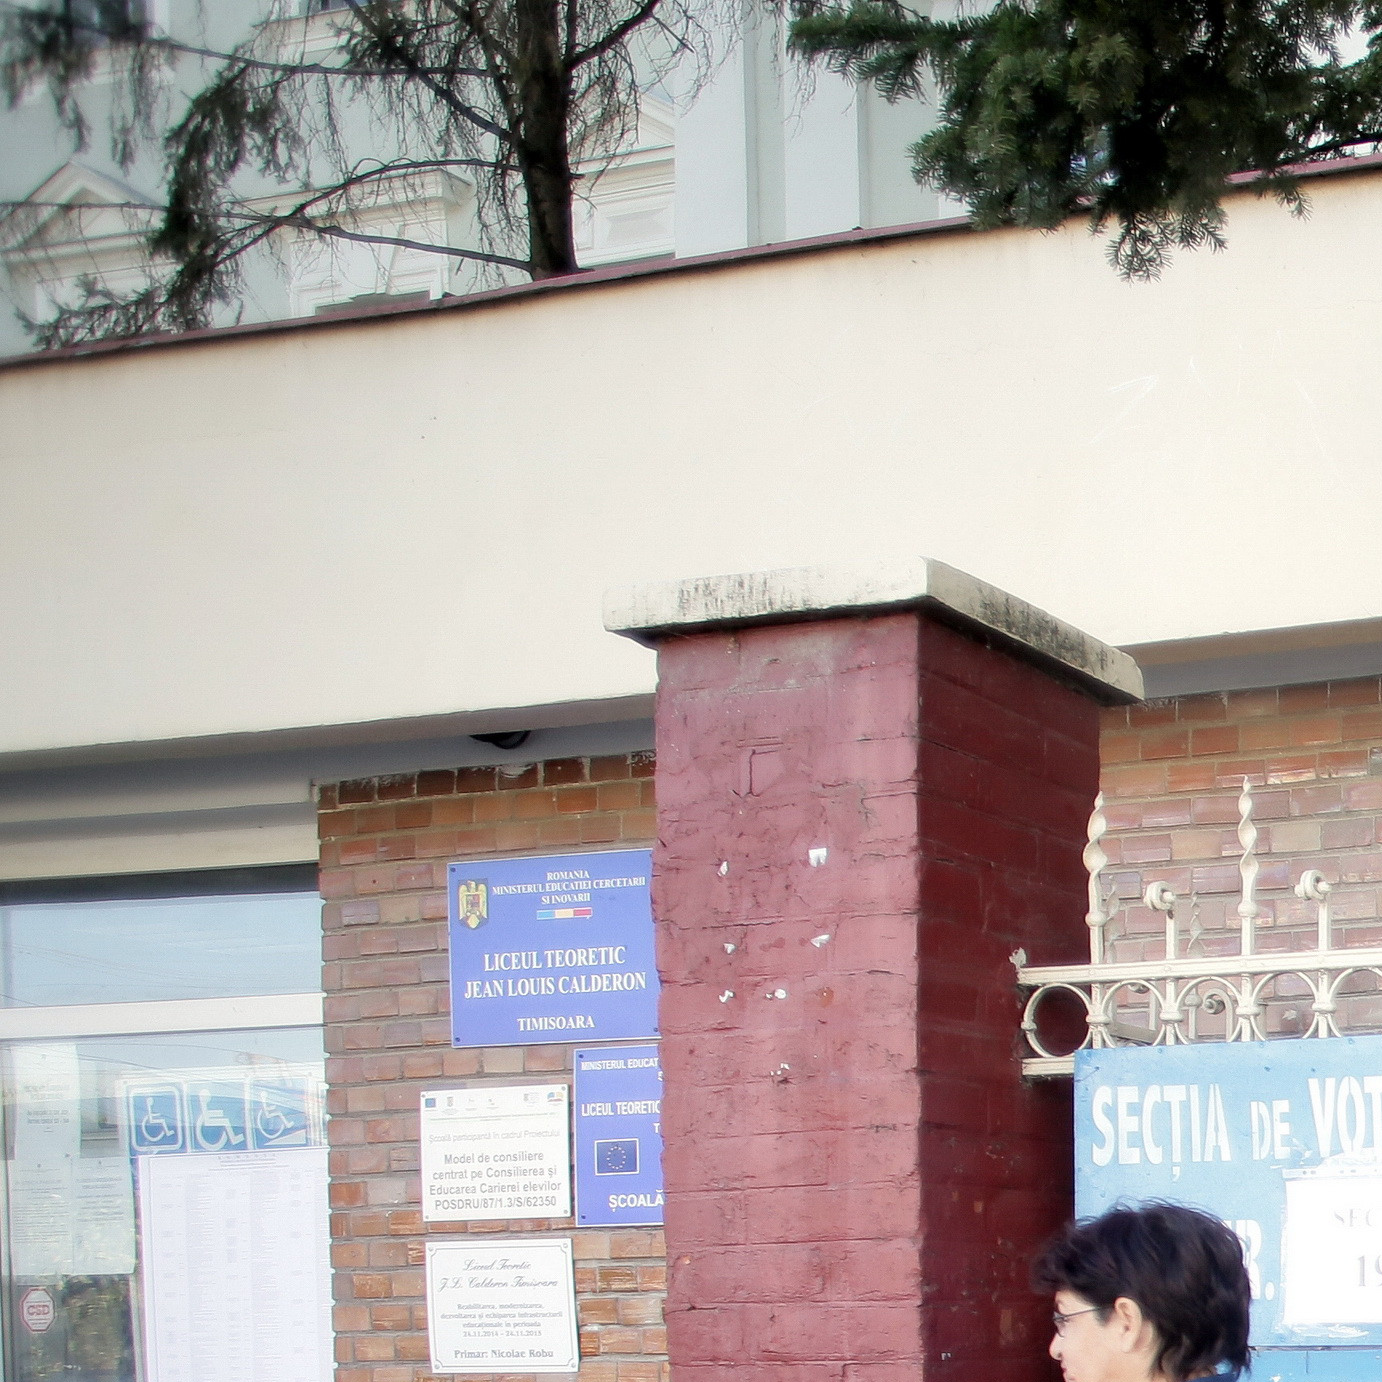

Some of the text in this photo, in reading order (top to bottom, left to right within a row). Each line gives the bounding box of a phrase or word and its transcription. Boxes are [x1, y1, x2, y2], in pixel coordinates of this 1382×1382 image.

[546, 869, 590, 881] ROMANIA
[492, 876, 646, 895] MINISTERUL EDUCATIEI CERCETARII
[551, 892, 591, 905] INOVARII
[483, 946, 627, 972] LICEUL TEORETIC
[464, 971, 647, 999] JEAN LOUIS CALDERON
[516, 1015, 596, 1032] TIMISOARA
[581, 1059, 627, 1071] MINISTERUL
[581, 1102, 615, 1117] LICEUL
[1091, 1082, 1232, 1182] SECȚIA
[1250, 1099, 1291, 1161] DE
[444, 1151, 544, 1165] Model de consiliere
[432, 1169, 468, 1180] centrat
[470, 1169, 483, 1181] pe
[486, 1165, 545, 1179] Consilierea
[429, 1181, 562, 1196] Educarea Carierei elevilor
[608, 1189, 665, 1212] ȘCOALĂ
[1221, 1219, 1275, 1301] R.
[454, 1348, 554, 1359] Primar: Nicolae Robu
